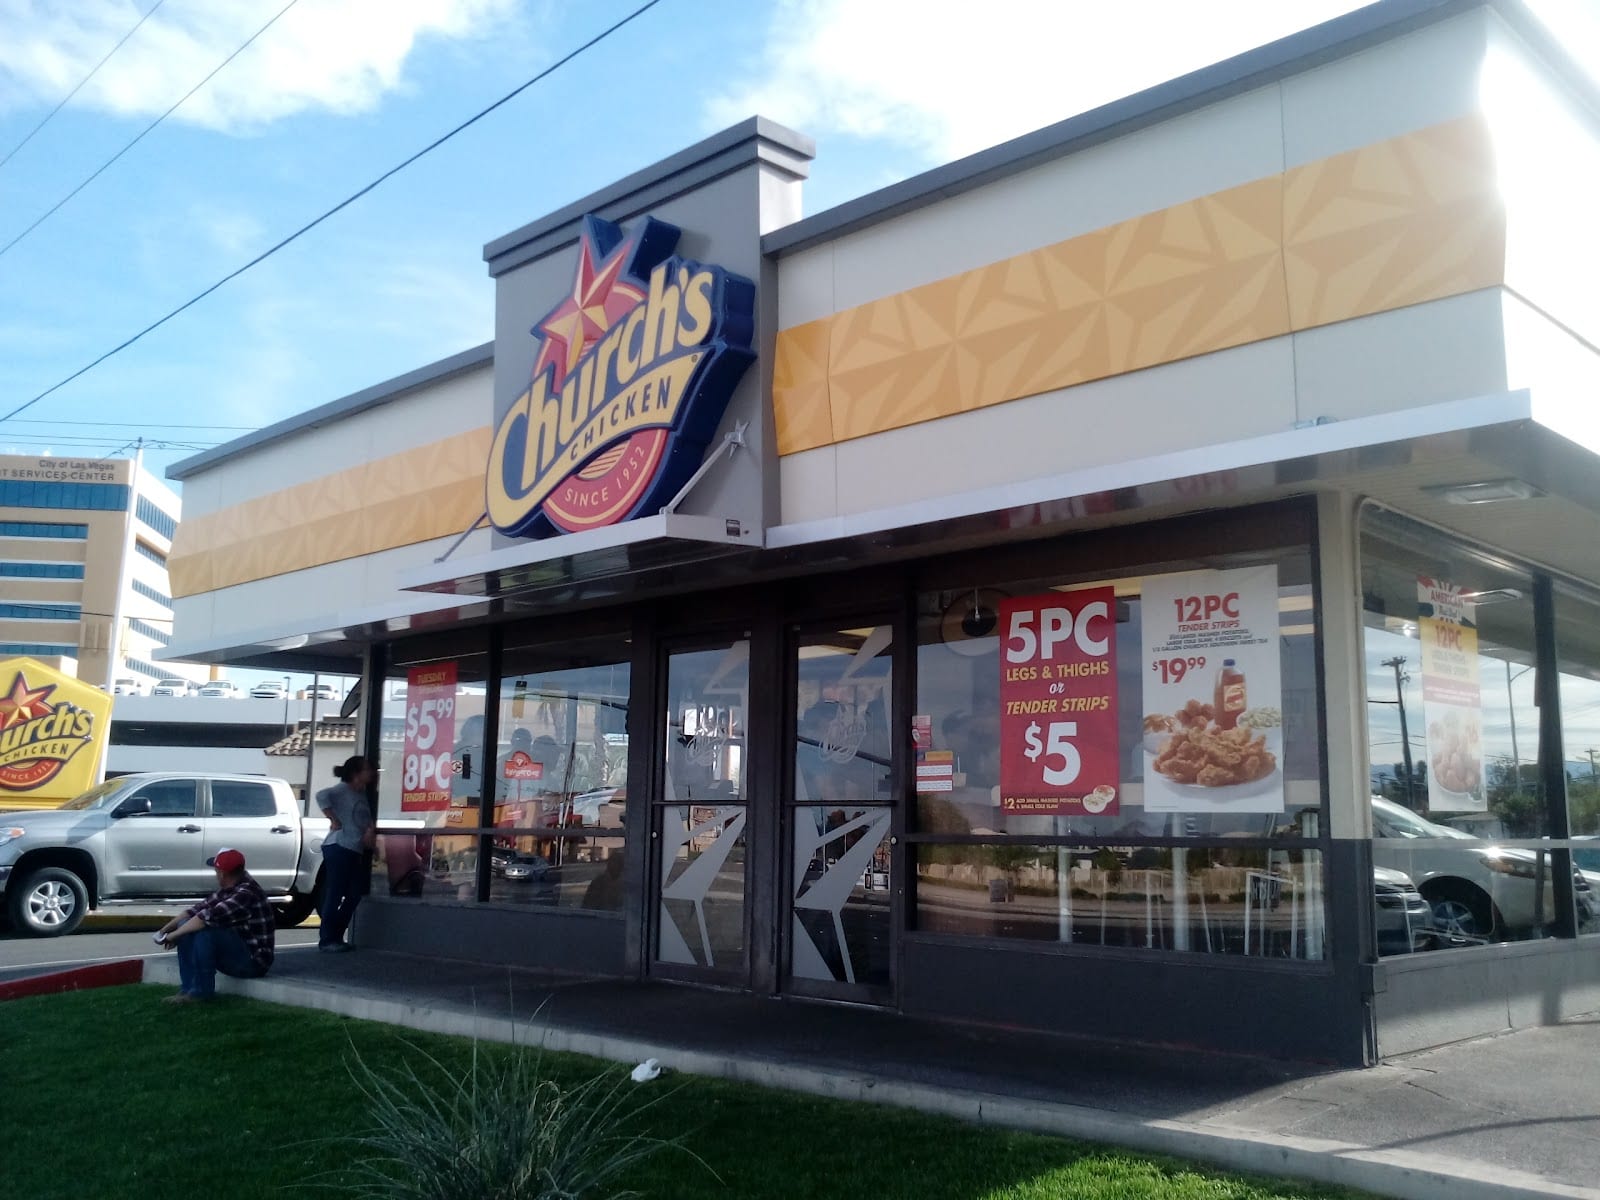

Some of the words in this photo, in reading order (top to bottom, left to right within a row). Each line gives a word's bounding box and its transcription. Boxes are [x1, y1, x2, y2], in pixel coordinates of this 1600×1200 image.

[487, 265, 713, 528] Church's
[570, 375, 672, 461] CHICKEN
[11, 469, 67, 480] SERVICES
[70, 472, 114, 481] CENTER
[39, 459, 56, 469] City
[59, 461, 68, 469] of
[70, 461, 85, 471] Las
[88, 462, 114, 472] Vegas
[564, 488, 609, 507] SINCE
[616, 445, 645, 490] 1952
[1174, 592, 1239, 622] 12PC
[1006, 601, 1109, 664] 5PC
[1178, 622, 1208, 632] TENDER
[1212, 620, 1239, 630] STRIPS
[1435, 624, 1462, 652] 12PC
[1006, 665, 1037, 682] LEGS
[1042, 664, 1052, 680] &
[1057, 660, 1109, 679] THIGHS
[1049, 681, 1065, 694] or
[1006, 700, 1057, 716] TENDER
[1061, 696, 1109, 712] STRIPS
[4, 744, 69, 762] CHICKEN
[1023, 720, 1081, 786] $5
[404, 752, 451, 790] 8PC
